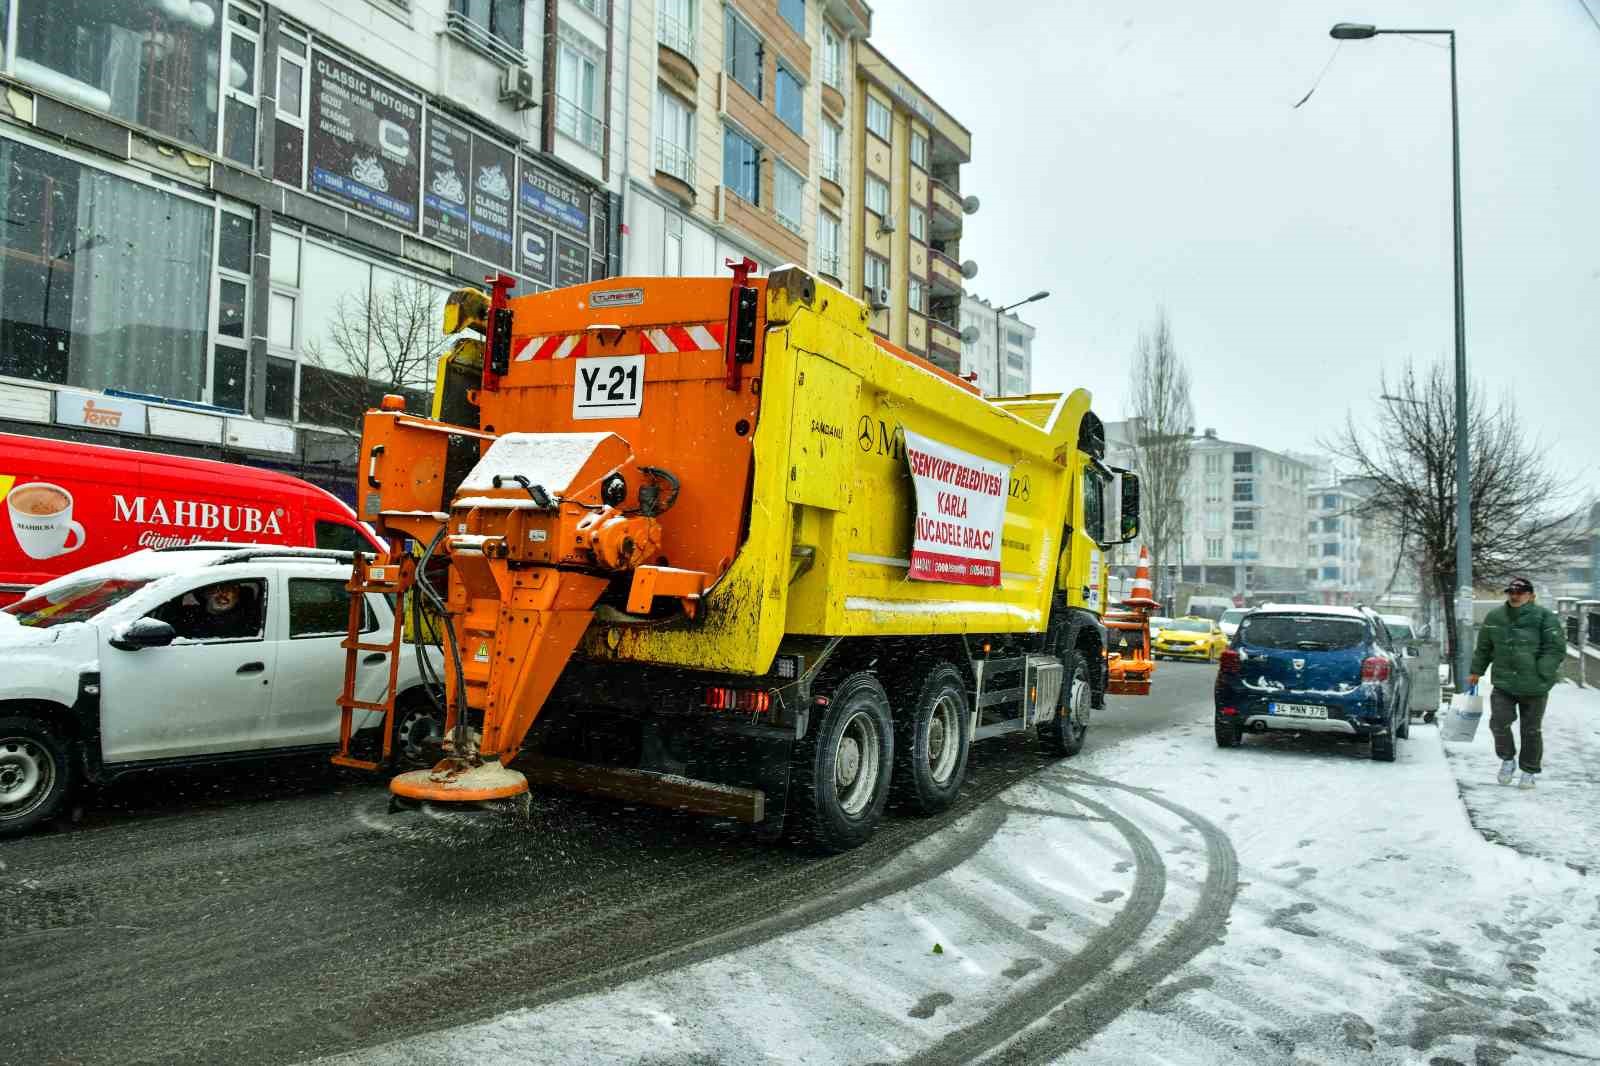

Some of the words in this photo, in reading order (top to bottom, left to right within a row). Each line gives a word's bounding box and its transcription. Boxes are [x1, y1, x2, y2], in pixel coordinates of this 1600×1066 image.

[317, 60, 367, 94] CLASSIC
[371, 86, 416, 119] MOTORS
[475, 194, 508, 216] CLASSIC
[475, 206, 508, 228] MOTORS
[580, 364, 638, 402] Y-21
[954, 465, 1003, 497] BELEDİYESİ
[112, 494, 283, 536] MAHBUBA
[936, 491, 968, 518] KARLA
[962, 526, 995, 553] ARACI
